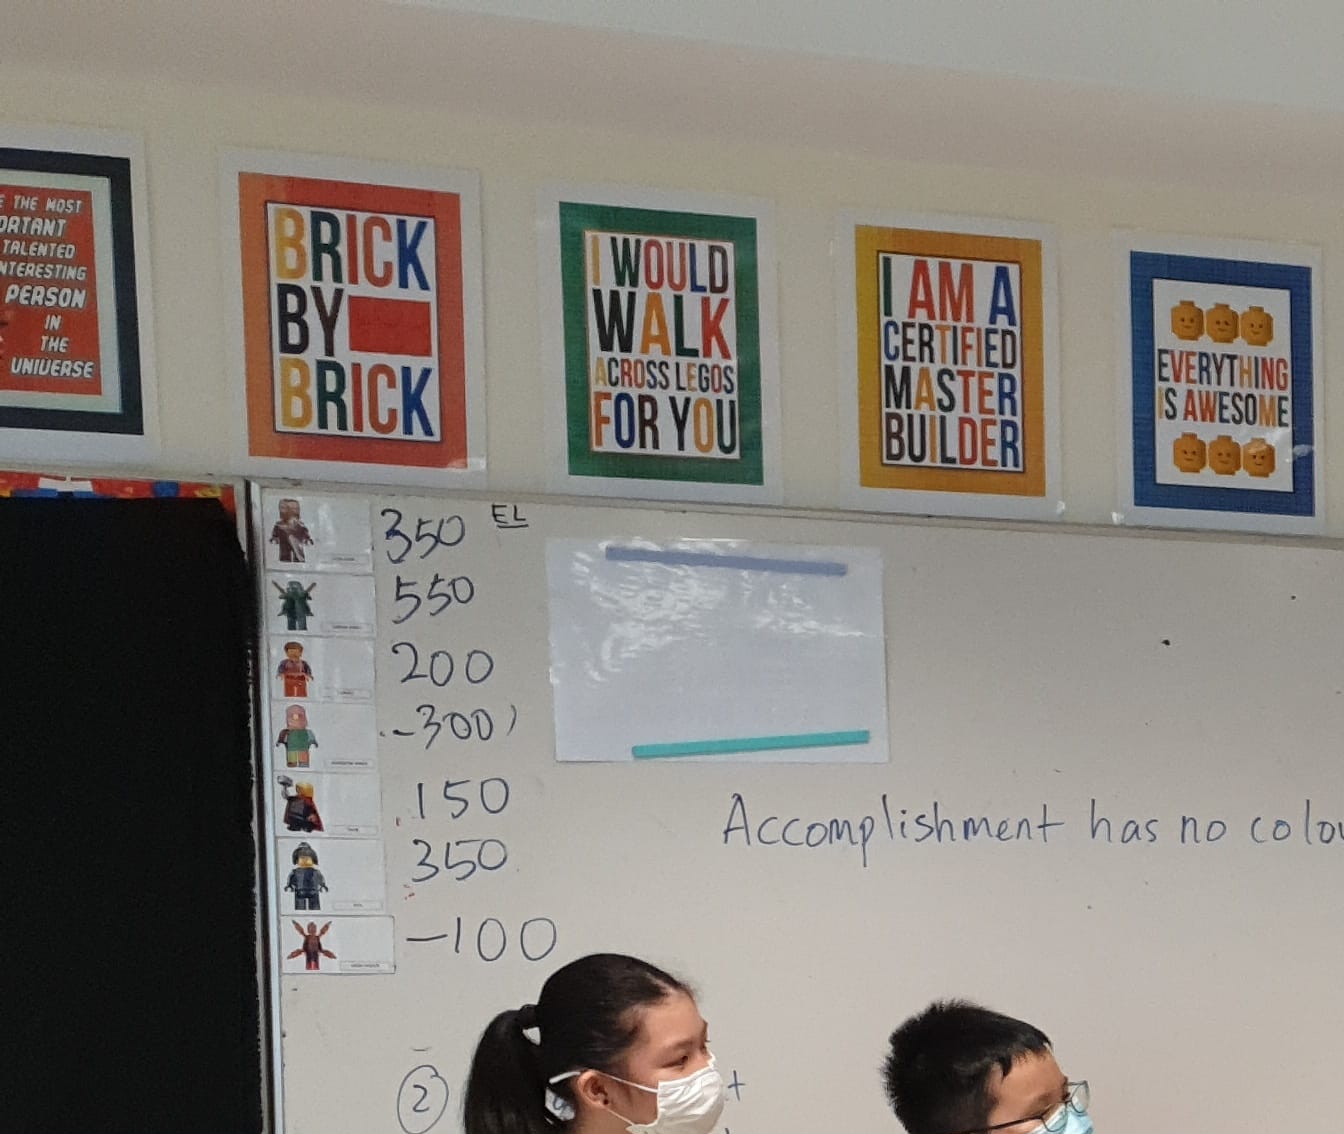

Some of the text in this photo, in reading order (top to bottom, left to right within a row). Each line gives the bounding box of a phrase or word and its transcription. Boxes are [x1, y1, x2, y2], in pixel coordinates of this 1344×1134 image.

[0, 215, 66, 237] ORTANT
[14, 195, 38, 210] THE
[47, 199, 82, 214] MOST
[0, 262, 87, 280] NTERESTING
[4, 239, 76, 259] TALENTED
[274, 207, 430, 291] BRICK
[592, 234, 728, 293] I WOULD
[6, 285, 86, 307] PERSON
[883, 256, 1017, 326] I AM A
[45, 315, 61, 330] IN
[279, 285, 343, 356] BY
[592, 289, 731, 359] WALK
[41, 336, 69, 353] THE
[883, 322, 1017, 369] CERTIFIED
[11, 357, 94, 378] UNIVERSE
[594, 358, 734, 394] ACROSS LEGOS
[1158, 347, 1288, 391] EVERYTHING
[281, 358, 434, 436] BRICK
[884, 364, 1018, 417] MASTER
[1158, 387, 1289, 428] IS AWESOME
[596, 392, 737, 454] FOR YOU
[884, 414, 1020, 469] BUILDER
[381, 504, 529, 564] 350 EL
[392, 573, 475, 624] 550
[392, 642, 494, 686] 200
[417, 778, 509, 819] 150
[722, 794, 1067, 868] Accomplishment
[1091, 798, 1157, 844] has
[1180, 814, 1227, 843] no
[412, 838, 508, 882] 350
[406, 917, 557, 961] -100
